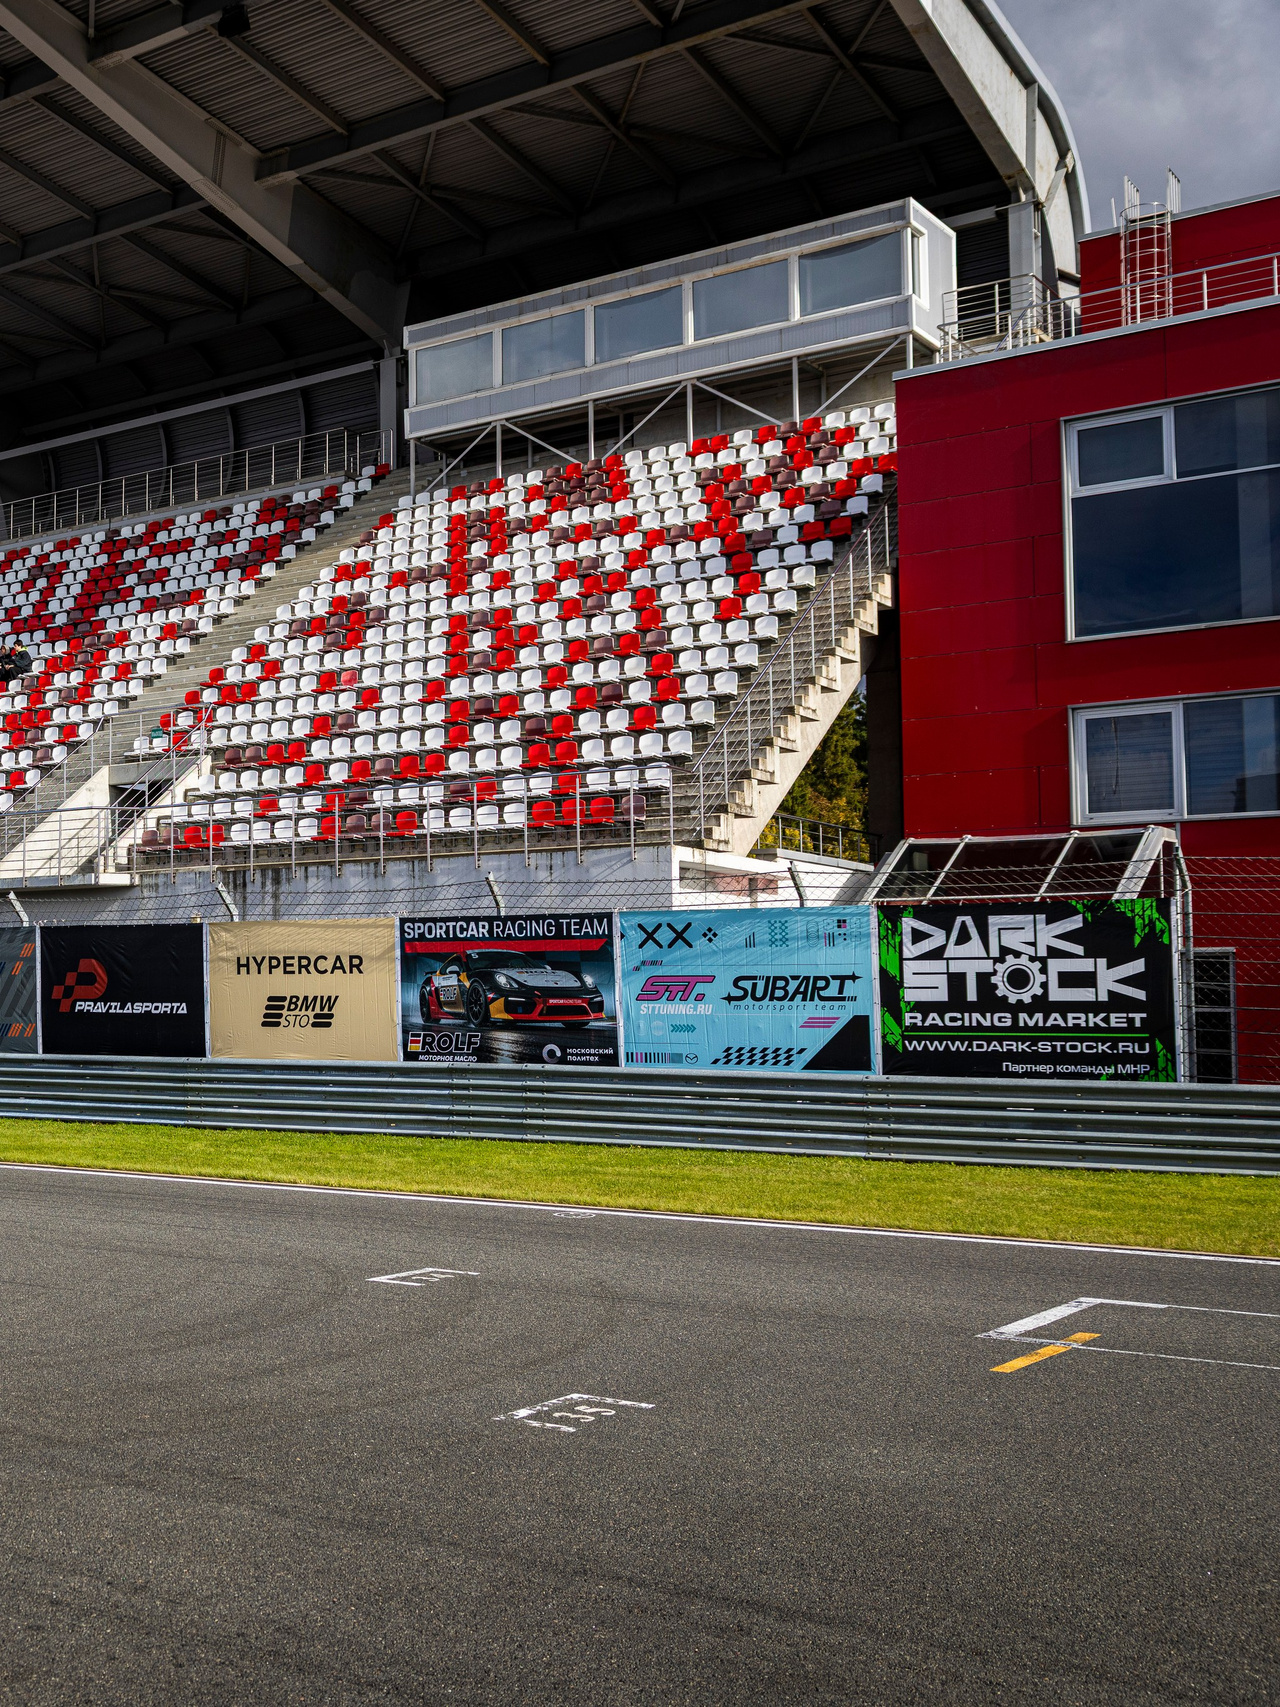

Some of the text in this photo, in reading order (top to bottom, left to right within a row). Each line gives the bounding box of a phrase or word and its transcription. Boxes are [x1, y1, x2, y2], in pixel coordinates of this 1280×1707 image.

[404, 918, 608, 938] SPORTCAR RACING TEAM
[902, 914, 1084, 958] DARK
[236, 955, 364, 974] HYPERCAR
[903, 954, 1146, 1004] STOCK
[75, 1002, 188, 1014] PRAVILASPORTA
[286, 995, 340, 1012] BMW
[640, 1003, 713, 1015] STTUNING.RU
[733, 1003, 806, 1012] motorsport
[282, 1014, 310, 1028] STO
[904, 1012, 1148, 1028] RACING MARKET
[420, 1032, 481, 1053] ROLF
[904, 1040, 1150, 1054] WWW.DARK-STOCK.RU
[418, 1054, 453, 1062] МОТОРНОЕ
[1002, 1062, 1150, 1074] Партнер команды МНР
[552, 1405, 616, 1422] 35
